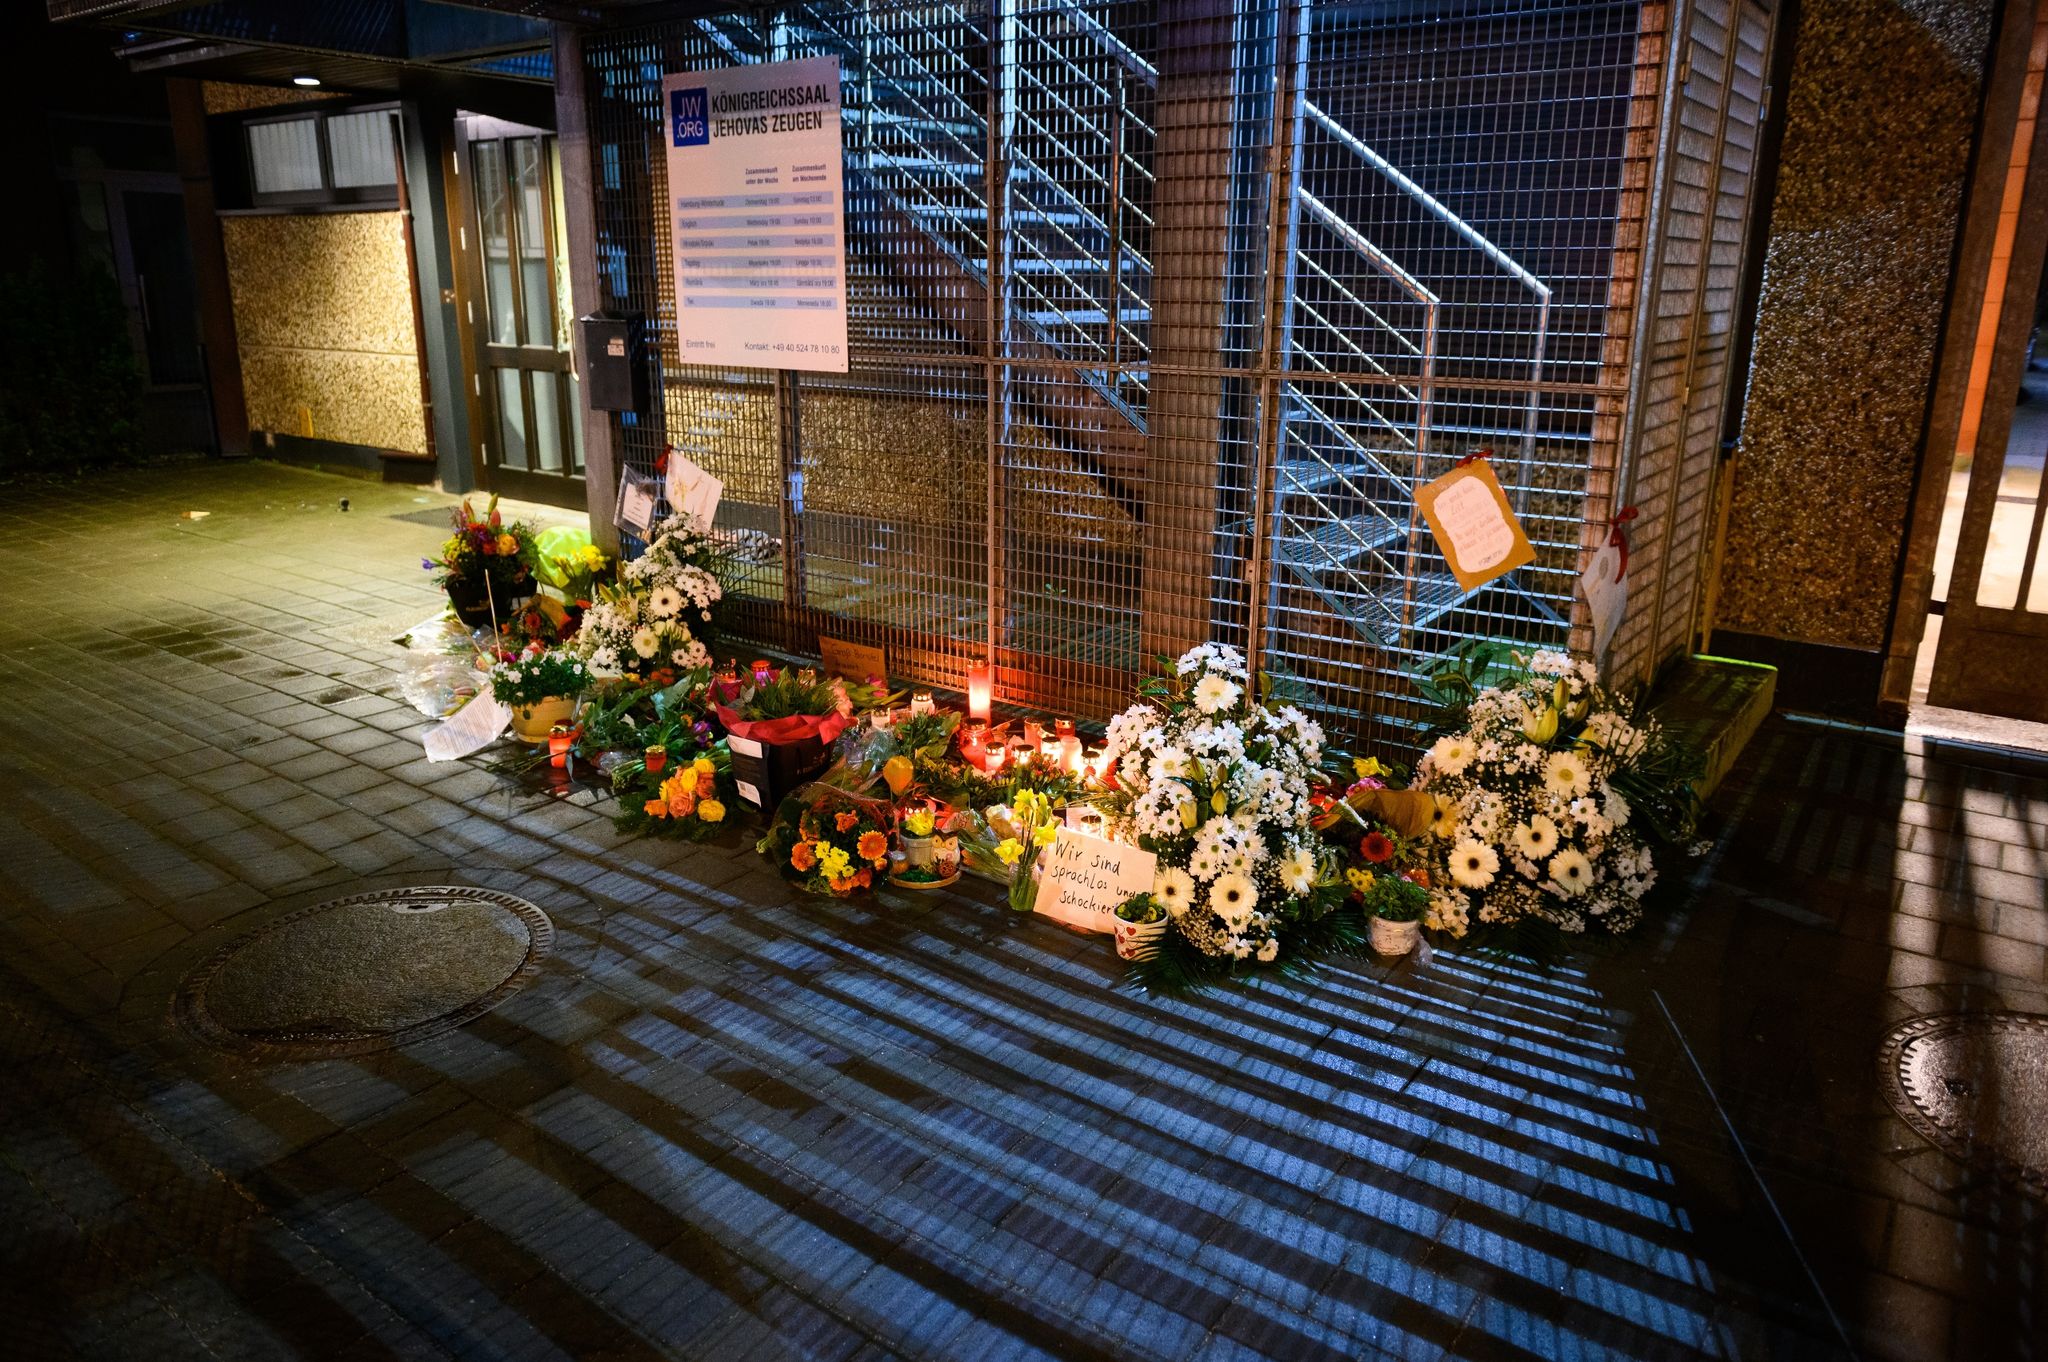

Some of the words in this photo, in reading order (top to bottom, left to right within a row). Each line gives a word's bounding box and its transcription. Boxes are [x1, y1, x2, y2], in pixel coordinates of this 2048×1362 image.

[712, 84, 831, 113] KÖNIGREICHSSAAL
[678, 96, 701, 119] JW
[677, 121, 704, 138] .ORG
[713, 115, 768, 138] JEHOVAS
[772, 111, 823, 133] ZEUGEN
[745, 166, 778, 175] Zusammenkunft
[792, 164, 827, 172] Zusammenkunft
[685, 339, 706, 349] Eintritt
[706, 340, 715, 349] frei
[772, 343, 785, 352] +49
[785, 344, 795, 352] 40
[796, 344, 809, 353] 524
[810, 344, 820, 353] 78
[821, 345, 830, 353] 10
[831, 345, 840, 354] 80
[1055, 836, 1084, 861] Wir
[1116, 886, 1136, 900] und
